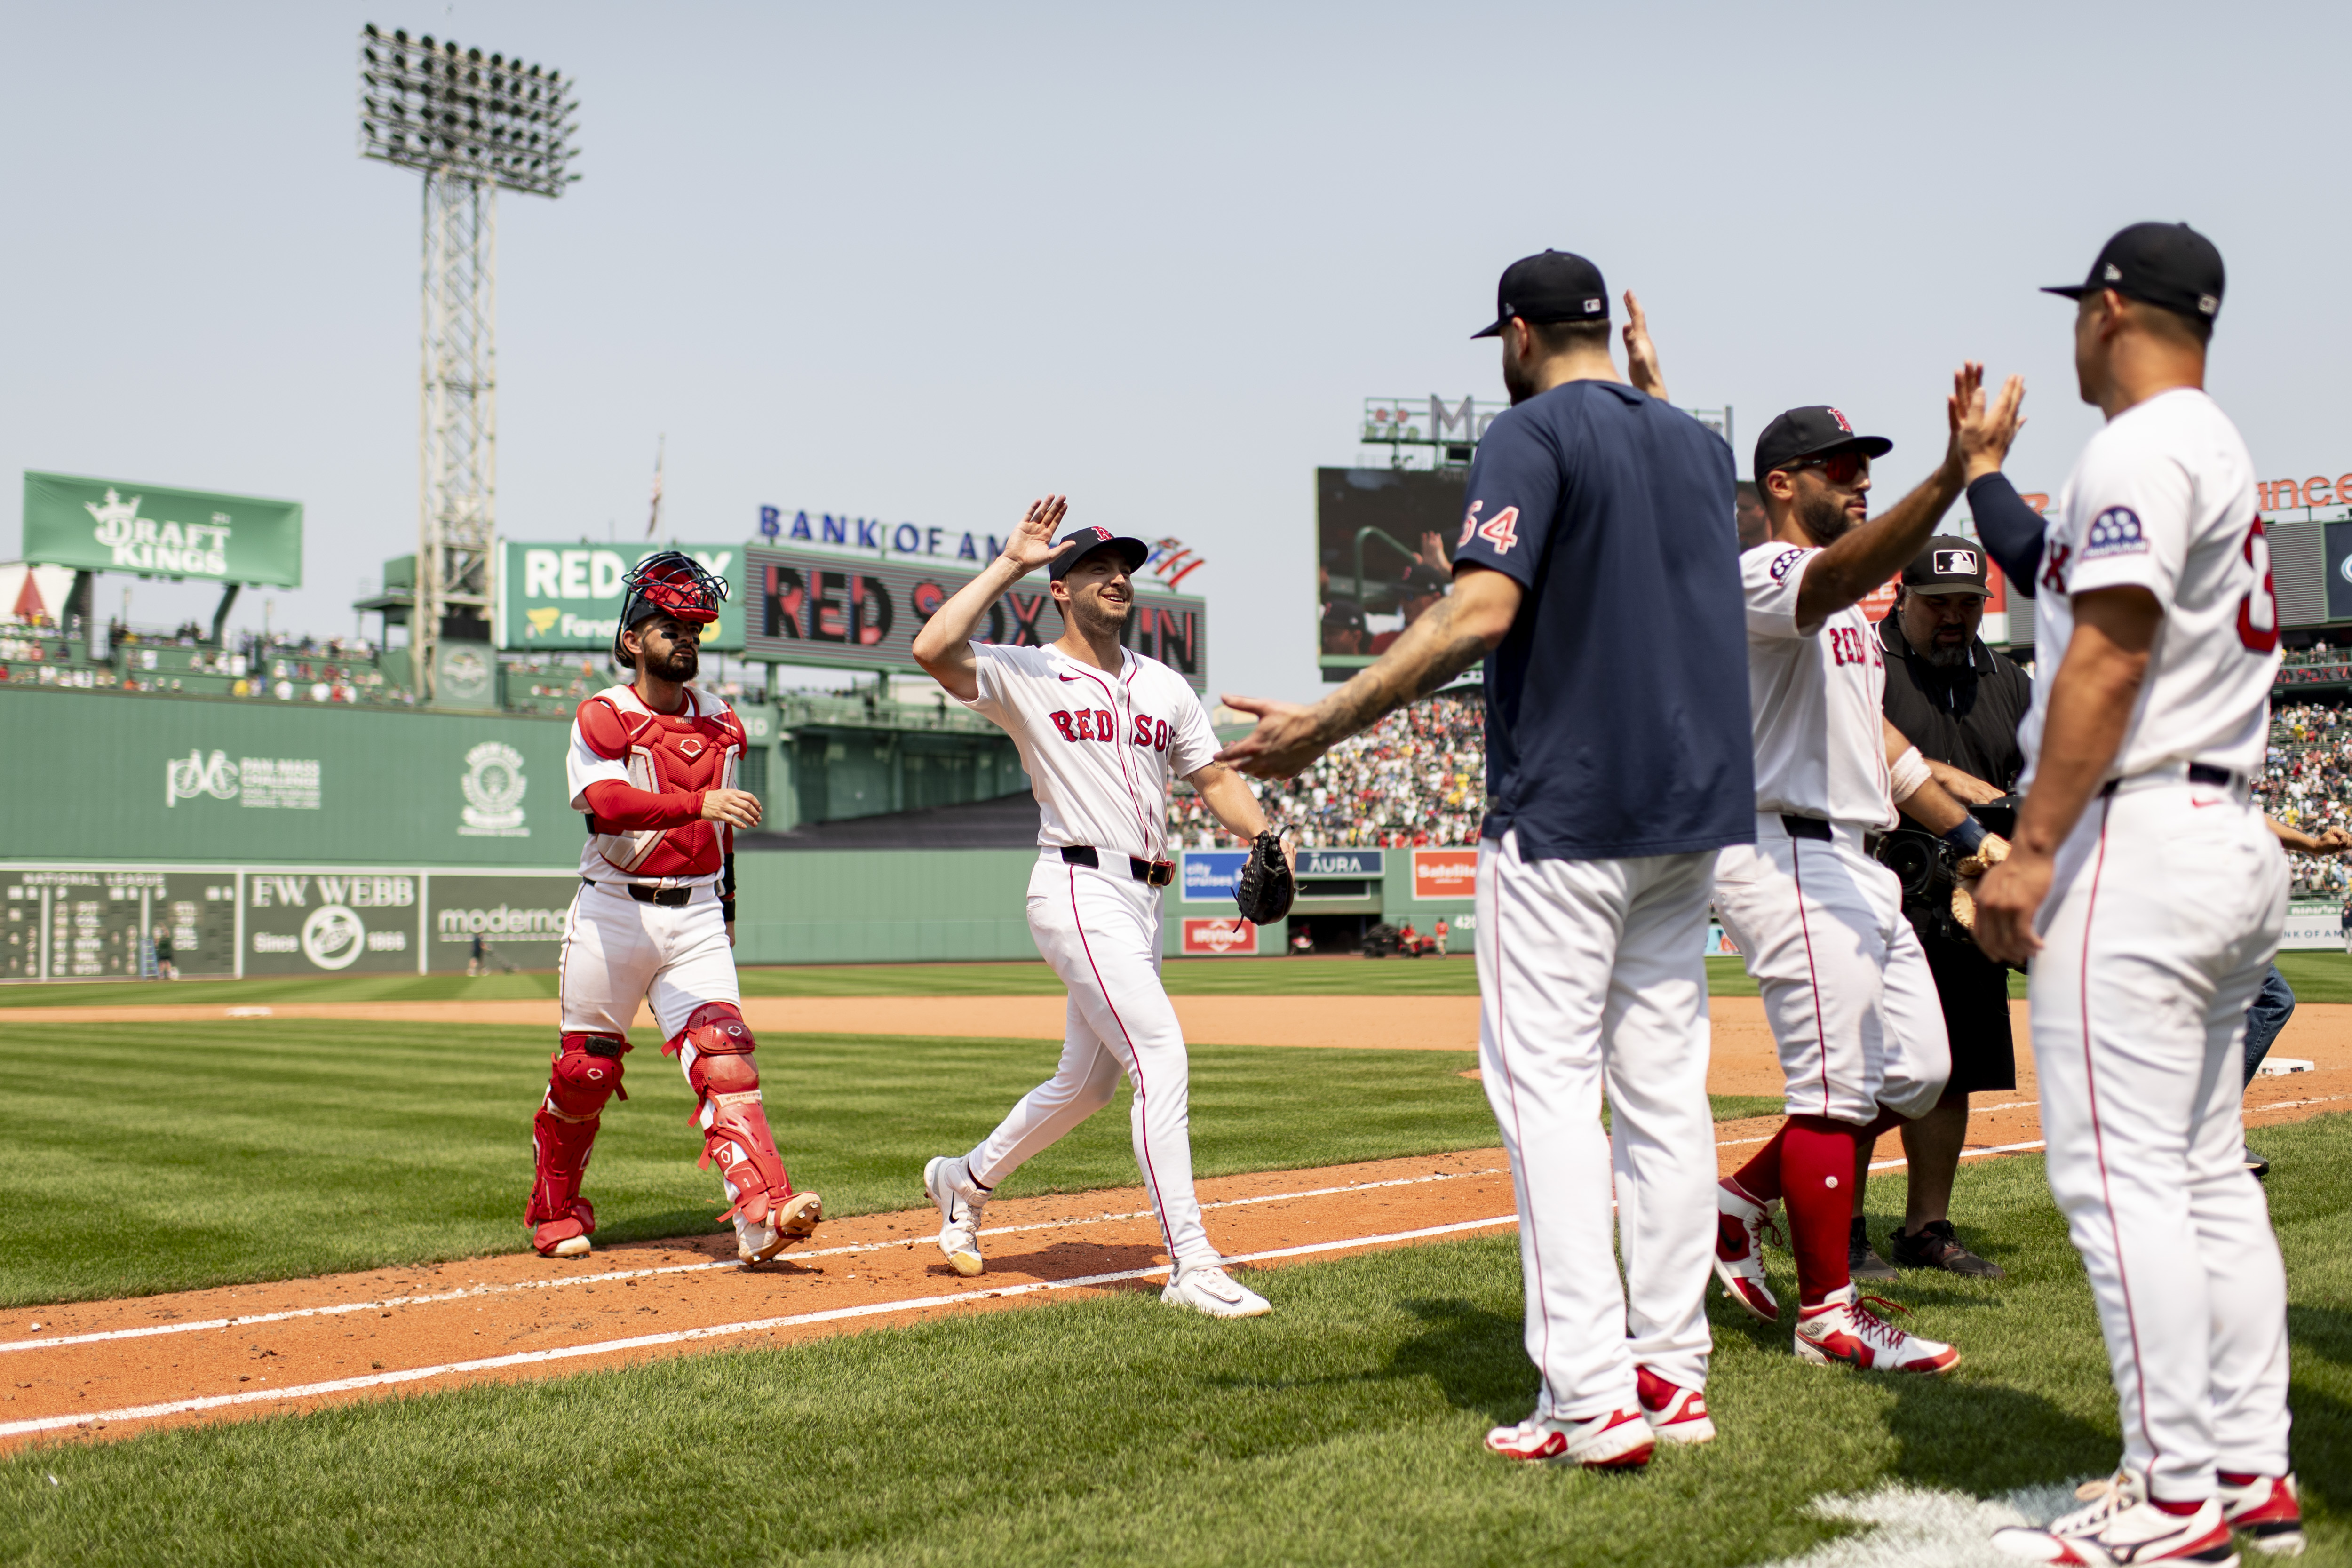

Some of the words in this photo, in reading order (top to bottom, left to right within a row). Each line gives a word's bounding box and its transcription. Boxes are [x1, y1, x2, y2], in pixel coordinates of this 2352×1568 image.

[94, 517, 231, 549] DRAFT
[760, 505, 878, 549] BANK
[896, 523, 942, 555] OF
[113, 541, 227, 575] KINGS
[525, 549, 626, 599] RED
[763, 566, 892, 645] RED
[1829, 627, 1865, 667] RED
[1049, 708, 1114, 742] RED
[22, 873, 100, 886] NATIONAL
[104, 873, 165, 886] LEAGUE
[1186, 861, 1212, 876] city
[1186, 876, 1234, 887] cruises
[317, 876, 414, 907] WEBB
[254, 931, 298, 953] Since
[1192, 927, 1247, 943] IRVING
